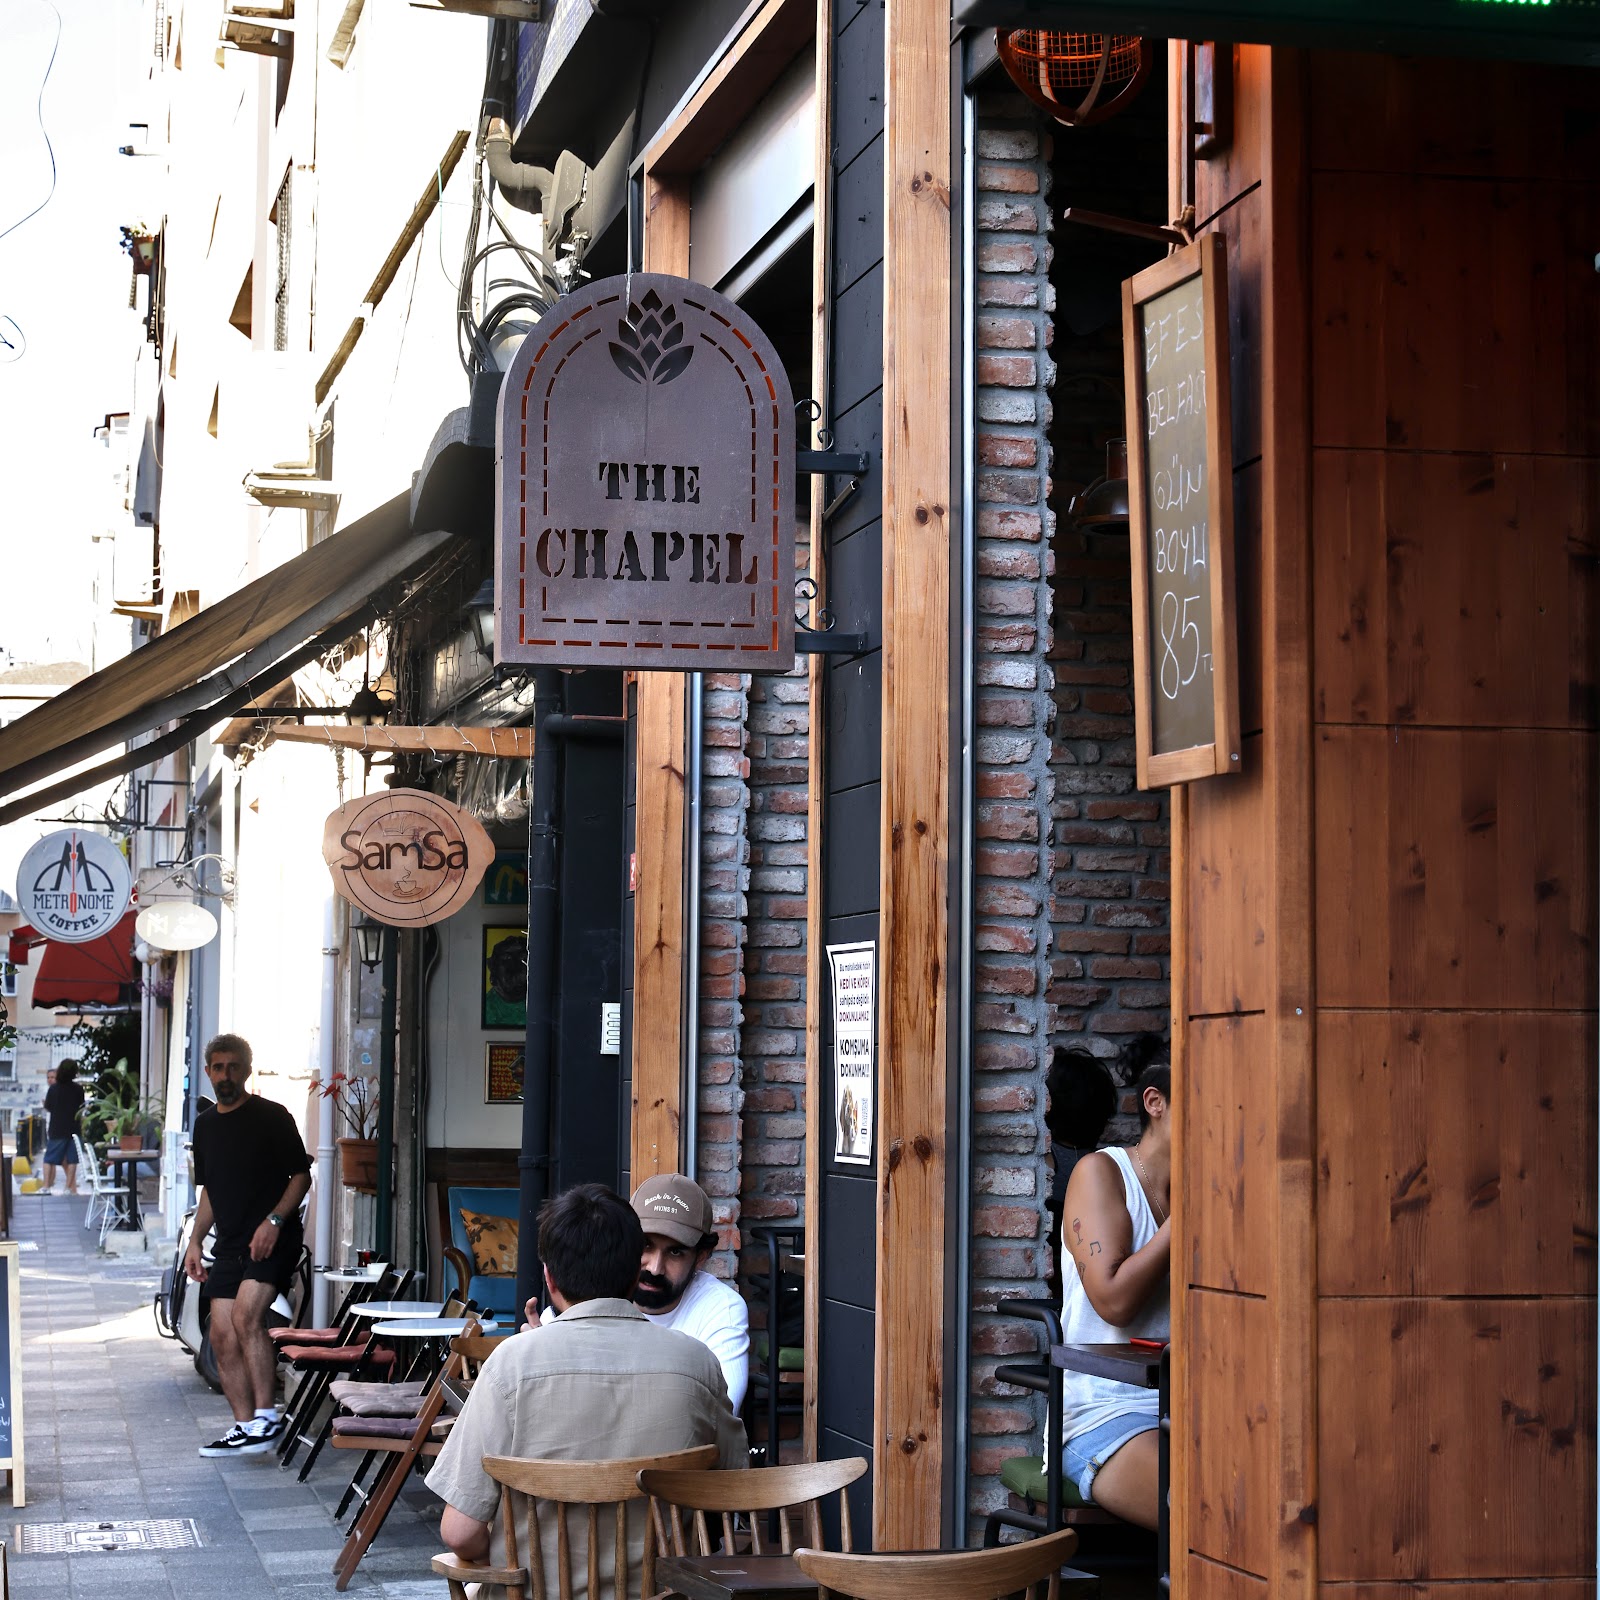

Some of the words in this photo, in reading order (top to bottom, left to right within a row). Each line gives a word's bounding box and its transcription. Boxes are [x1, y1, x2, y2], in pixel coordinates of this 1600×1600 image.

[1145, 297, 1203, 373] EFES
[599, 462, 701, 504] THE
[535, 528, 759, 584] CHAPEL
[1155, 522, 1206, 575] BOYU
[1160, 591, 1201, 700] 85
[340, 830, 469, 871] SamSa
[48, 913, 99, 931] COFFEE
[839, 1038, 870, 1059] KOMŞUMA
[645, 1193, 662, 1206] Back
[673, 1195, 690, 1211] Town
